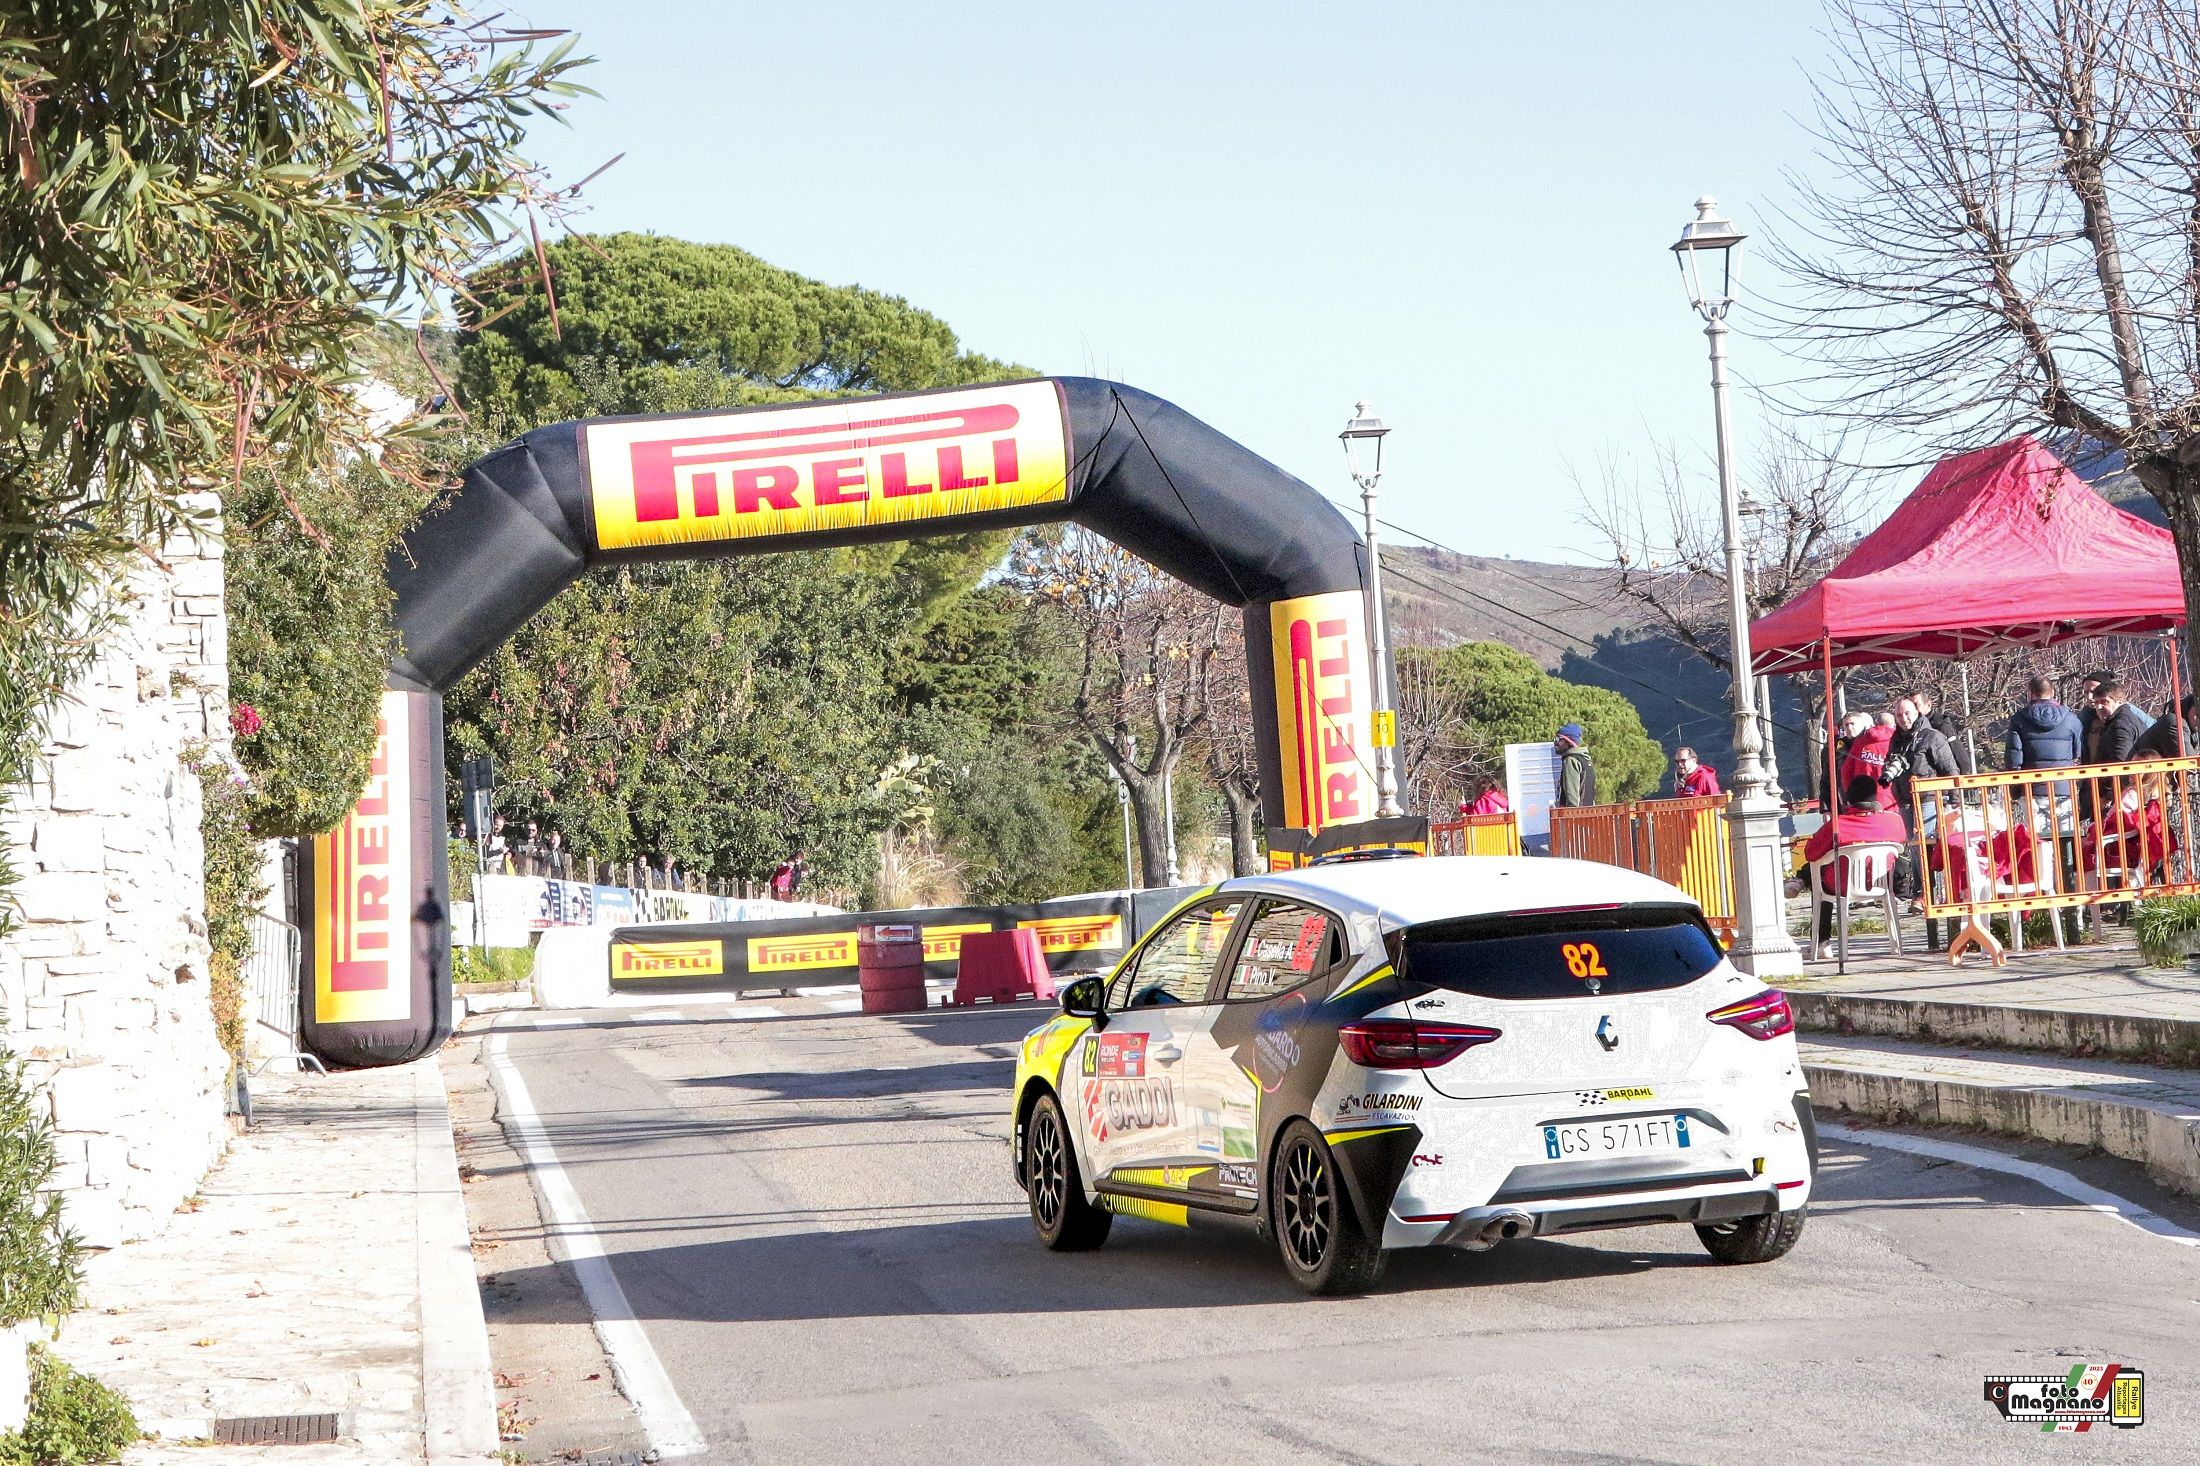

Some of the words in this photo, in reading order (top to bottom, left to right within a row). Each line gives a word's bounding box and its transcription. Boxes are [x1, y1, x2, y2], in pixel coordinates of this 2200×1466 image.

[630, 404, 1019, 522] PIRELLI
[1289, 619, 1360, 829] PRELLI
[1376, 723, 1389, 733] 10
[622, 948, 712, 971] PIRELLI
[758, 939, 848, 964] PIRELLI
[1258, 939, 1286, 959] Casella
[1562, 943, 1609, 978] 82
[1250, 966, 1268, 985] Pino
[1084, 1040, 1097, 1072] 82
[1105, 1077, 1178, 1130] GADDI
[1362, 1093, 1423, 1111] GILARDINI
[1607, 1087, 1653, 1101] BARDAHL
[1561, 1128, 1590, 1153] GS
[1602, 1121, 1671, 1150] 571FT
